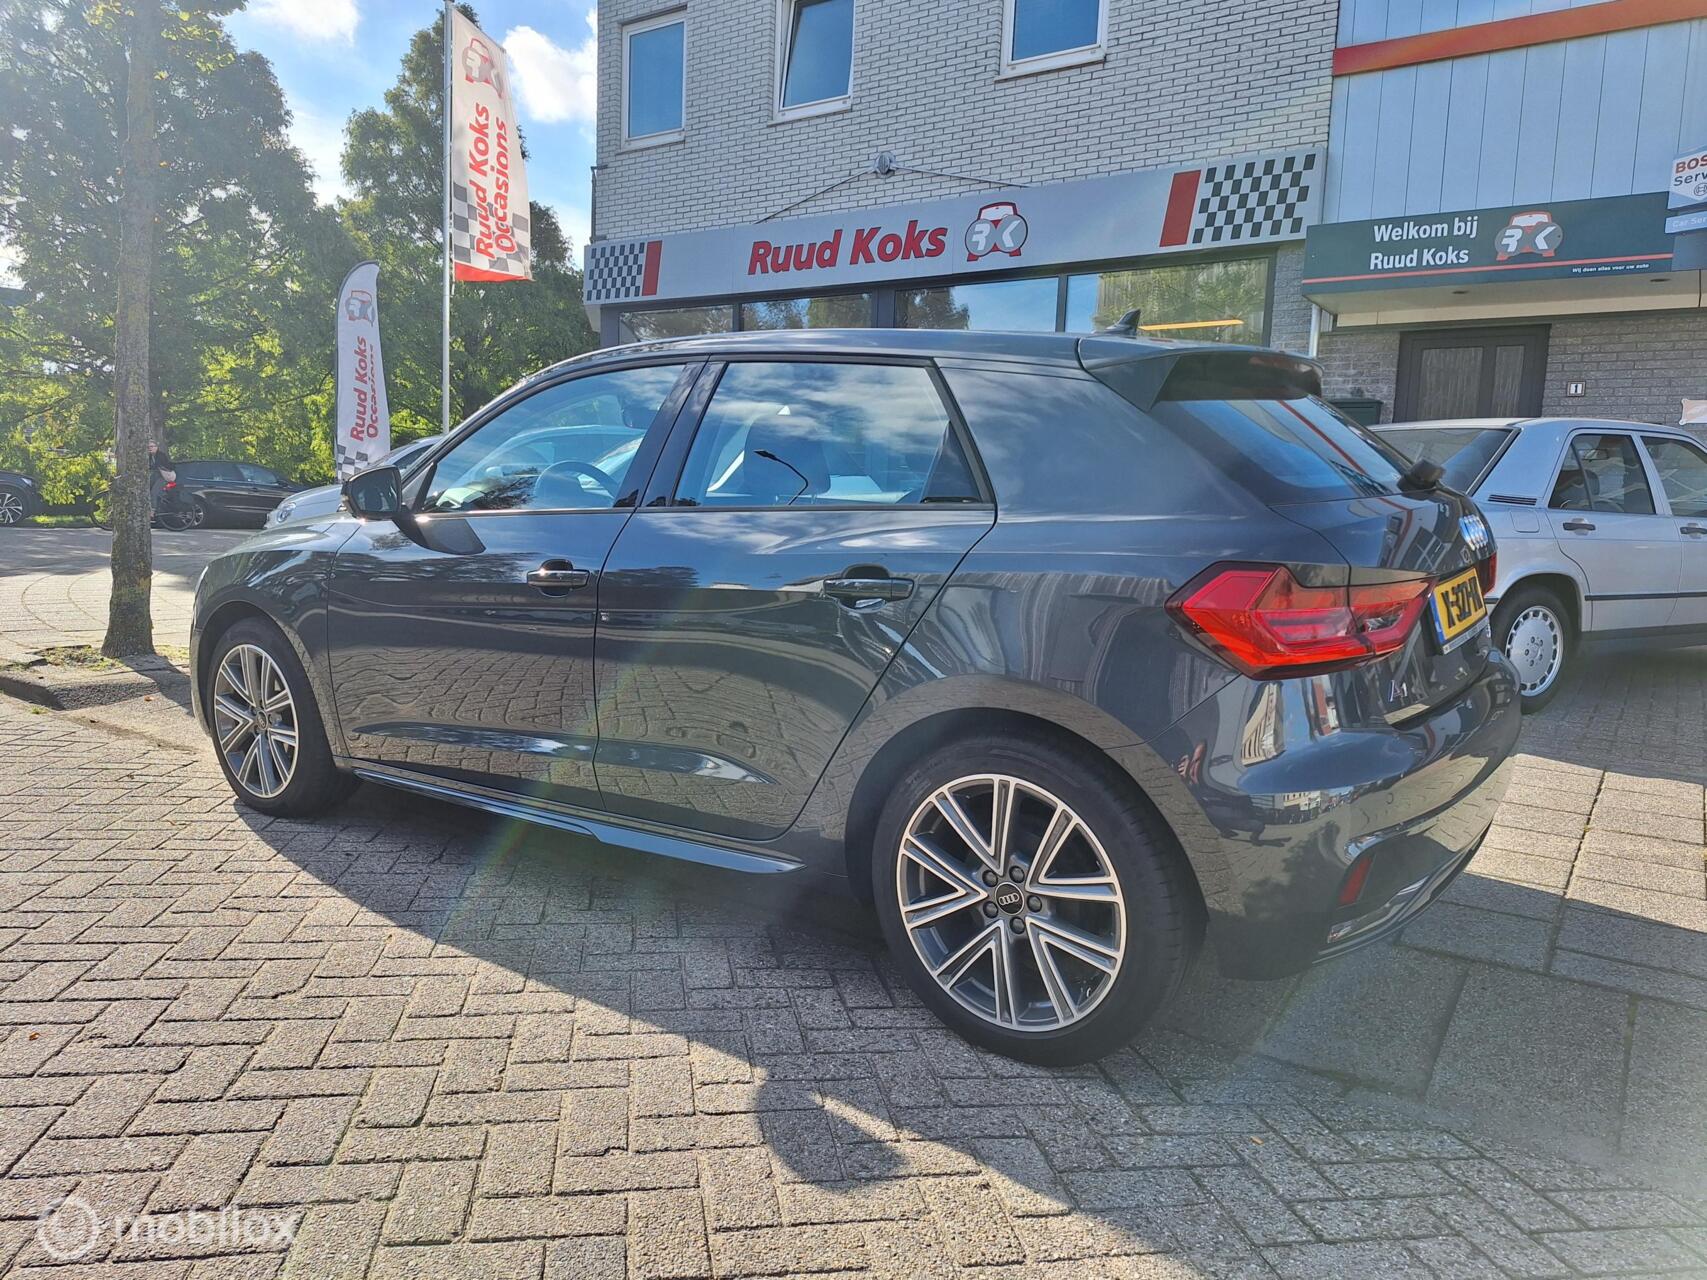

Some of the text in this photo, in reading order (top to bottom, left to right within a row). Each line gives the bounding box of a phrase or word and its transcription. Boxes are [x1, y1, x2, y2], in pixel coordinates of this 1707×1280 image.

[468, 102, 490, 177] Koks
[490, 117, 517, 254] Occasions
[469, 179, 495, 259] Ruud
[1373, 215, 1479, 242] Welkom bij
[748, 219, 948, 276] Ruud Koks
[1369, 246, 1469, 270] Ruud Koks
[354, 336, 368, 385] Koks
[351, 388, 367, 442] Ruud
